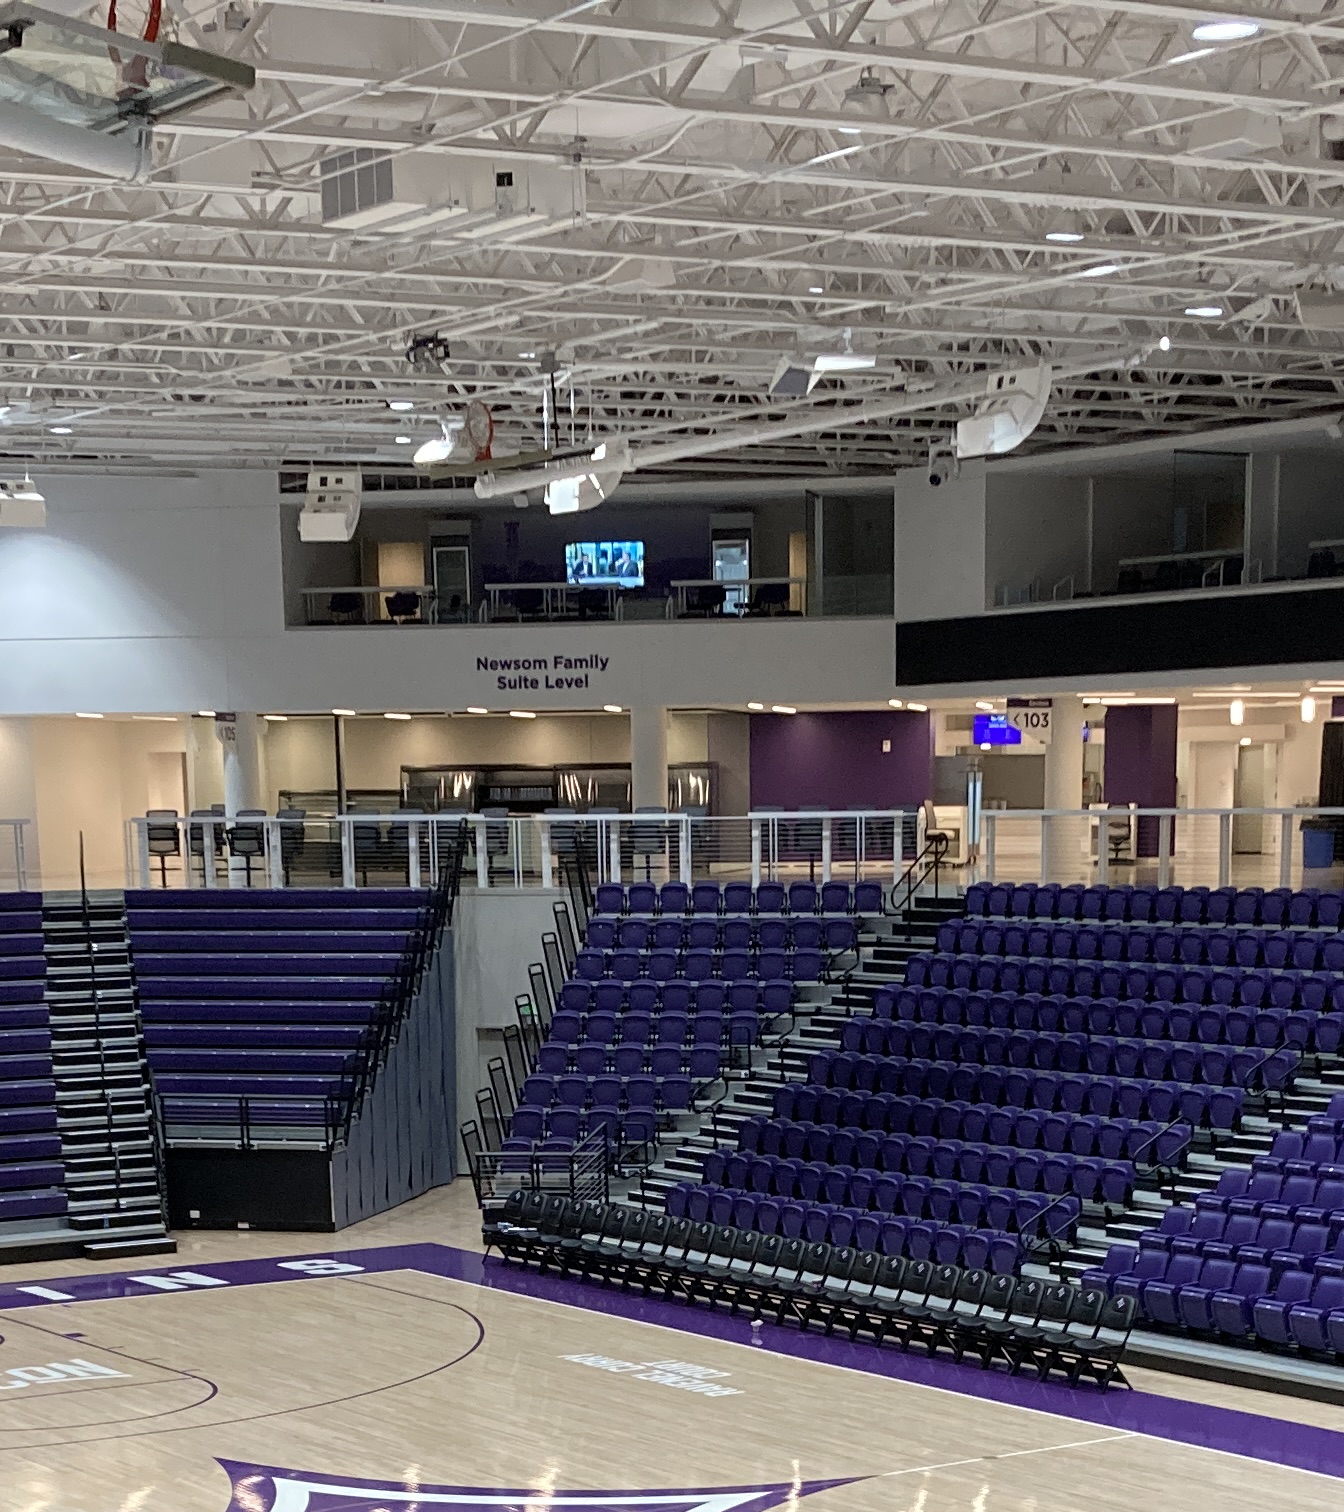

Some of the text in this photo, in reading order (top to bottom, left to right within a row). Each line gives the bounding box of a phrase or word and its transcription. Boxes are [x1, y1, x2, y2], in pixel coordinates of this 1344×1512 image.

[476, 654, 609, 672] Newsom Family
[497, 673, 589, 690] Suite Level
[1023, 712, 1050, 728] 103
